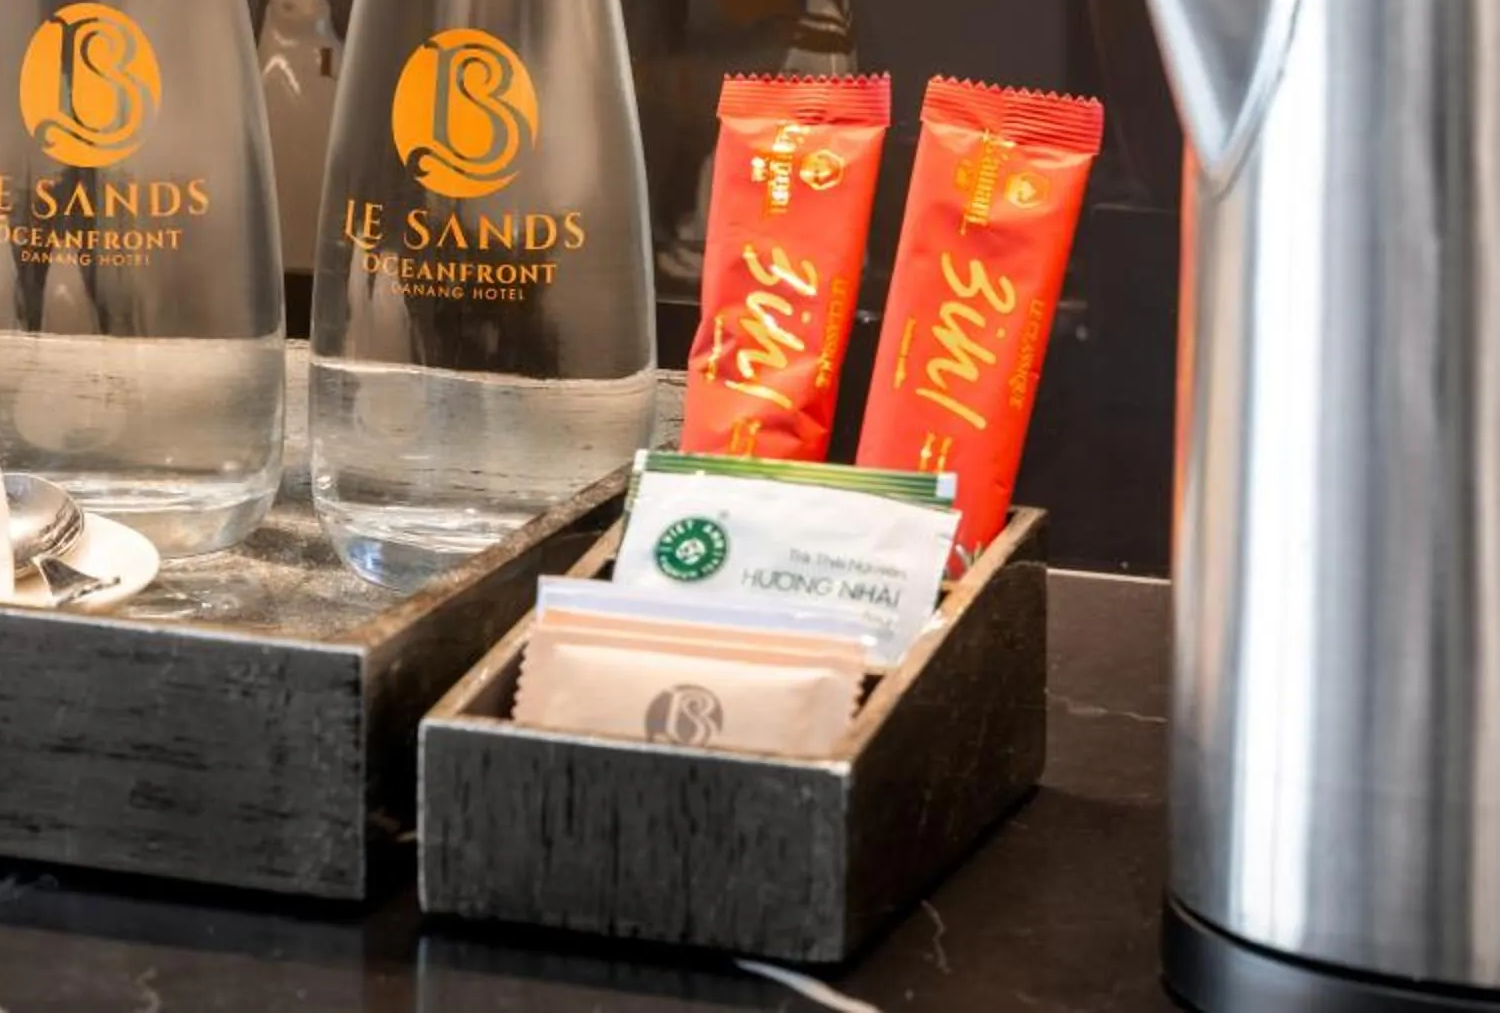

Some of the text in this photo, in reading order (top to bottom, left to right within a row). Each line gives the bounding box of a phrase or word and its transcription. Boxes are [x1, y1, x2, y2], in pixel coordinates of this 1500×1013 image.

[30, 177, 210, 220] SANDS
[345, 199, 585, 251] LE SANDS
[20, 250, 151, 267] DANANG HOTEL
[362, 251, 557, 285] OCEANFRONT
[390, 281, 526, 301] DANANG HOTEL
